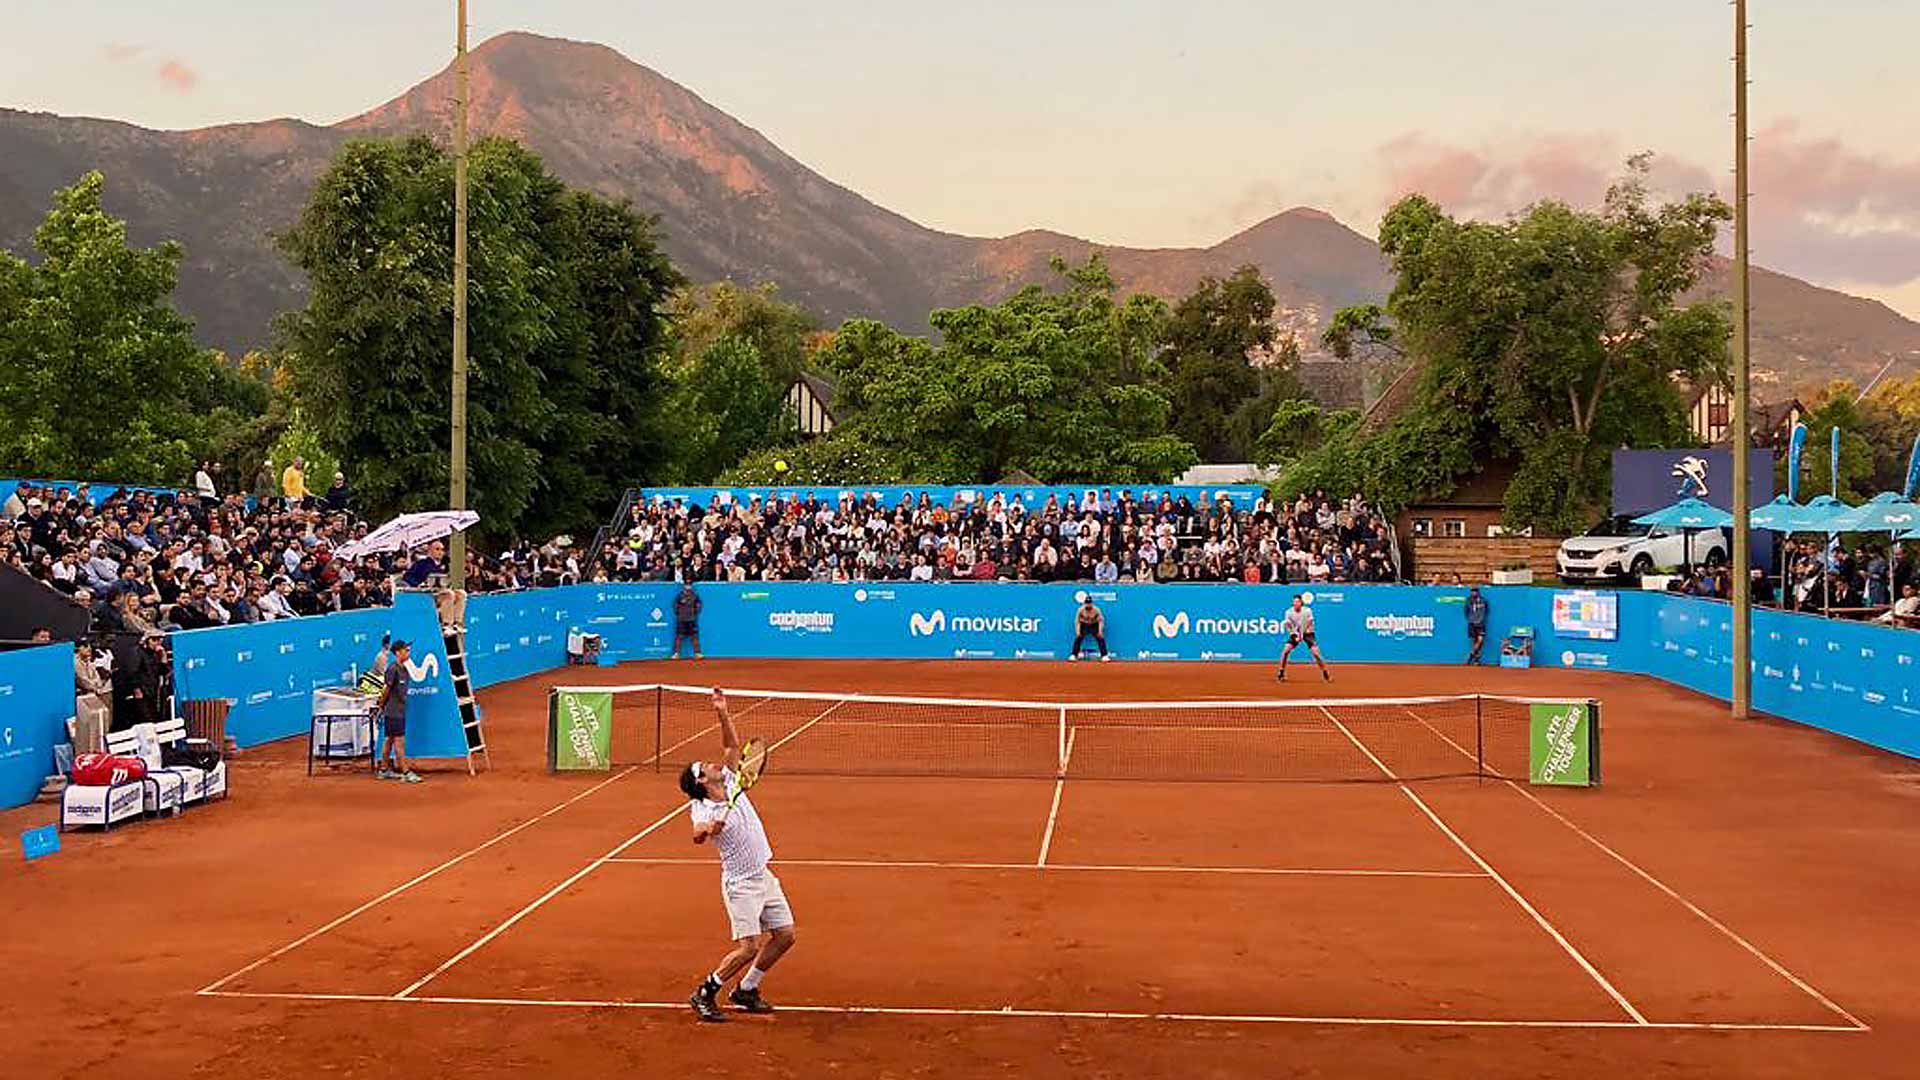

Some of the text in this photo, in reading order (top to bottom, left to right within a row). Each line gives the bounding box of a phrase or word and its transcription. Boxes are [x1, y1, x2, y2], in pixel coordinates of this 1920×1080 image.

[952, 615, 1042, 632] movistar
[1196, 617, 1287, 635] movistar
[1546, 714, 1567, 745] ATP
[1544, 707, 1583, 784] CHALLENGER
[1558, 741, 1577, 774] TOUR
